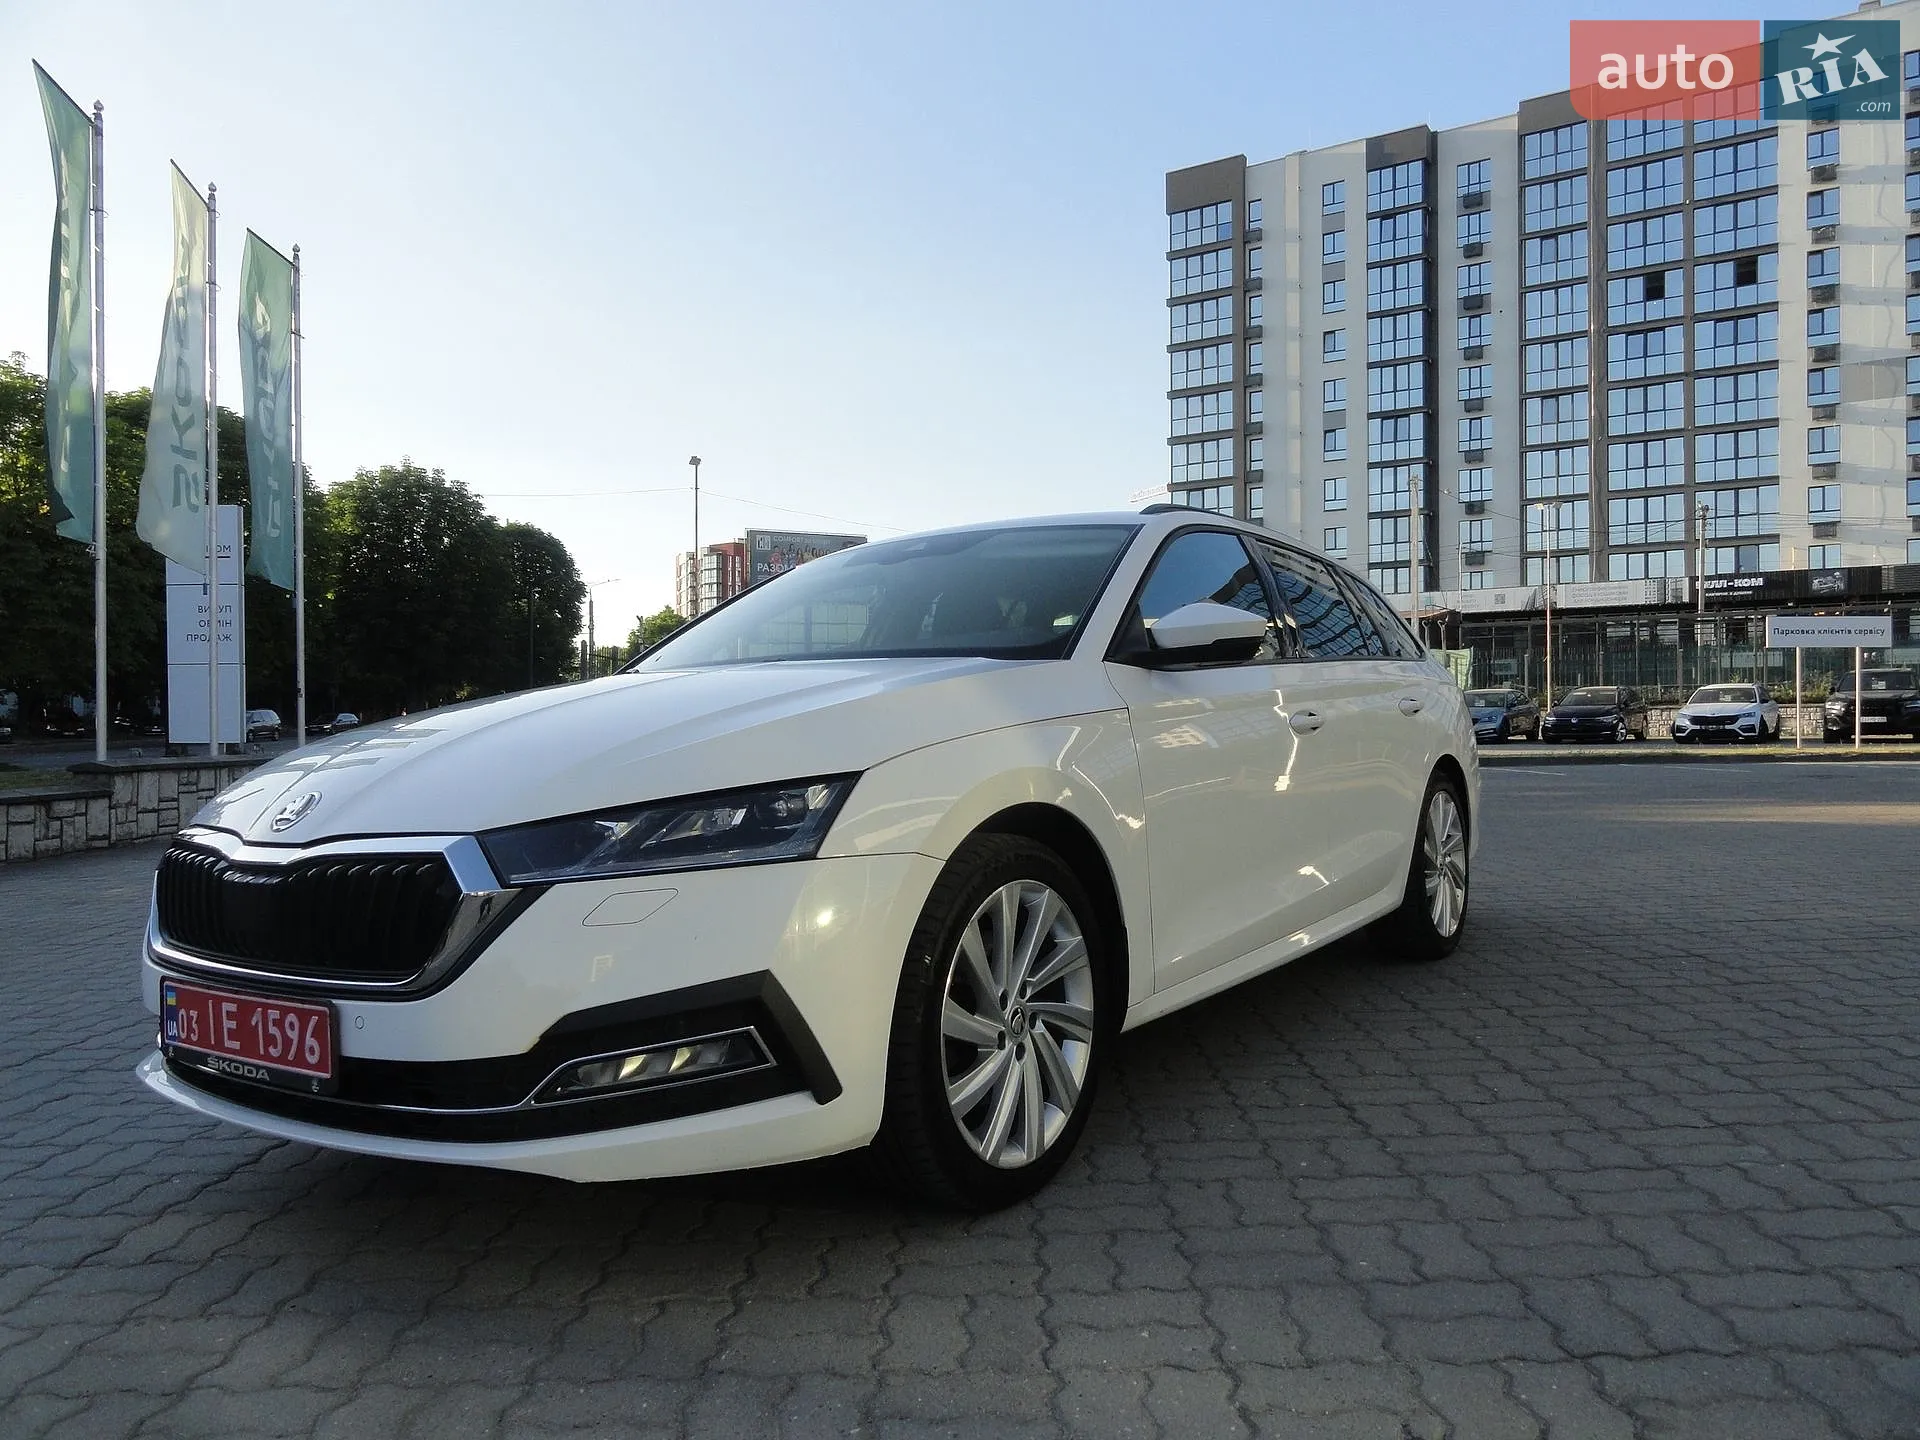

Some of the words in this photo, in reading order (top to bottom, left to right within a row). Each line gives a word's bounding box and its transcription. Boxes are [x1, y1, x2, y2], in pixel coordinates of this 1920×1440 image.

[197, 605, 232, 614] ВИУП
[1773, 627, 1816, 637] Парковка
[1817, 626, 1852, 636] клієнтів
[1853, 627, 1886, 637] сервісу
[167, 1021, 178, 1037] UA
[178, 1008, 199, 1042] 03
[208, 999, 241, 1050] IE
[251, 1007, 321, 1065] 1596
